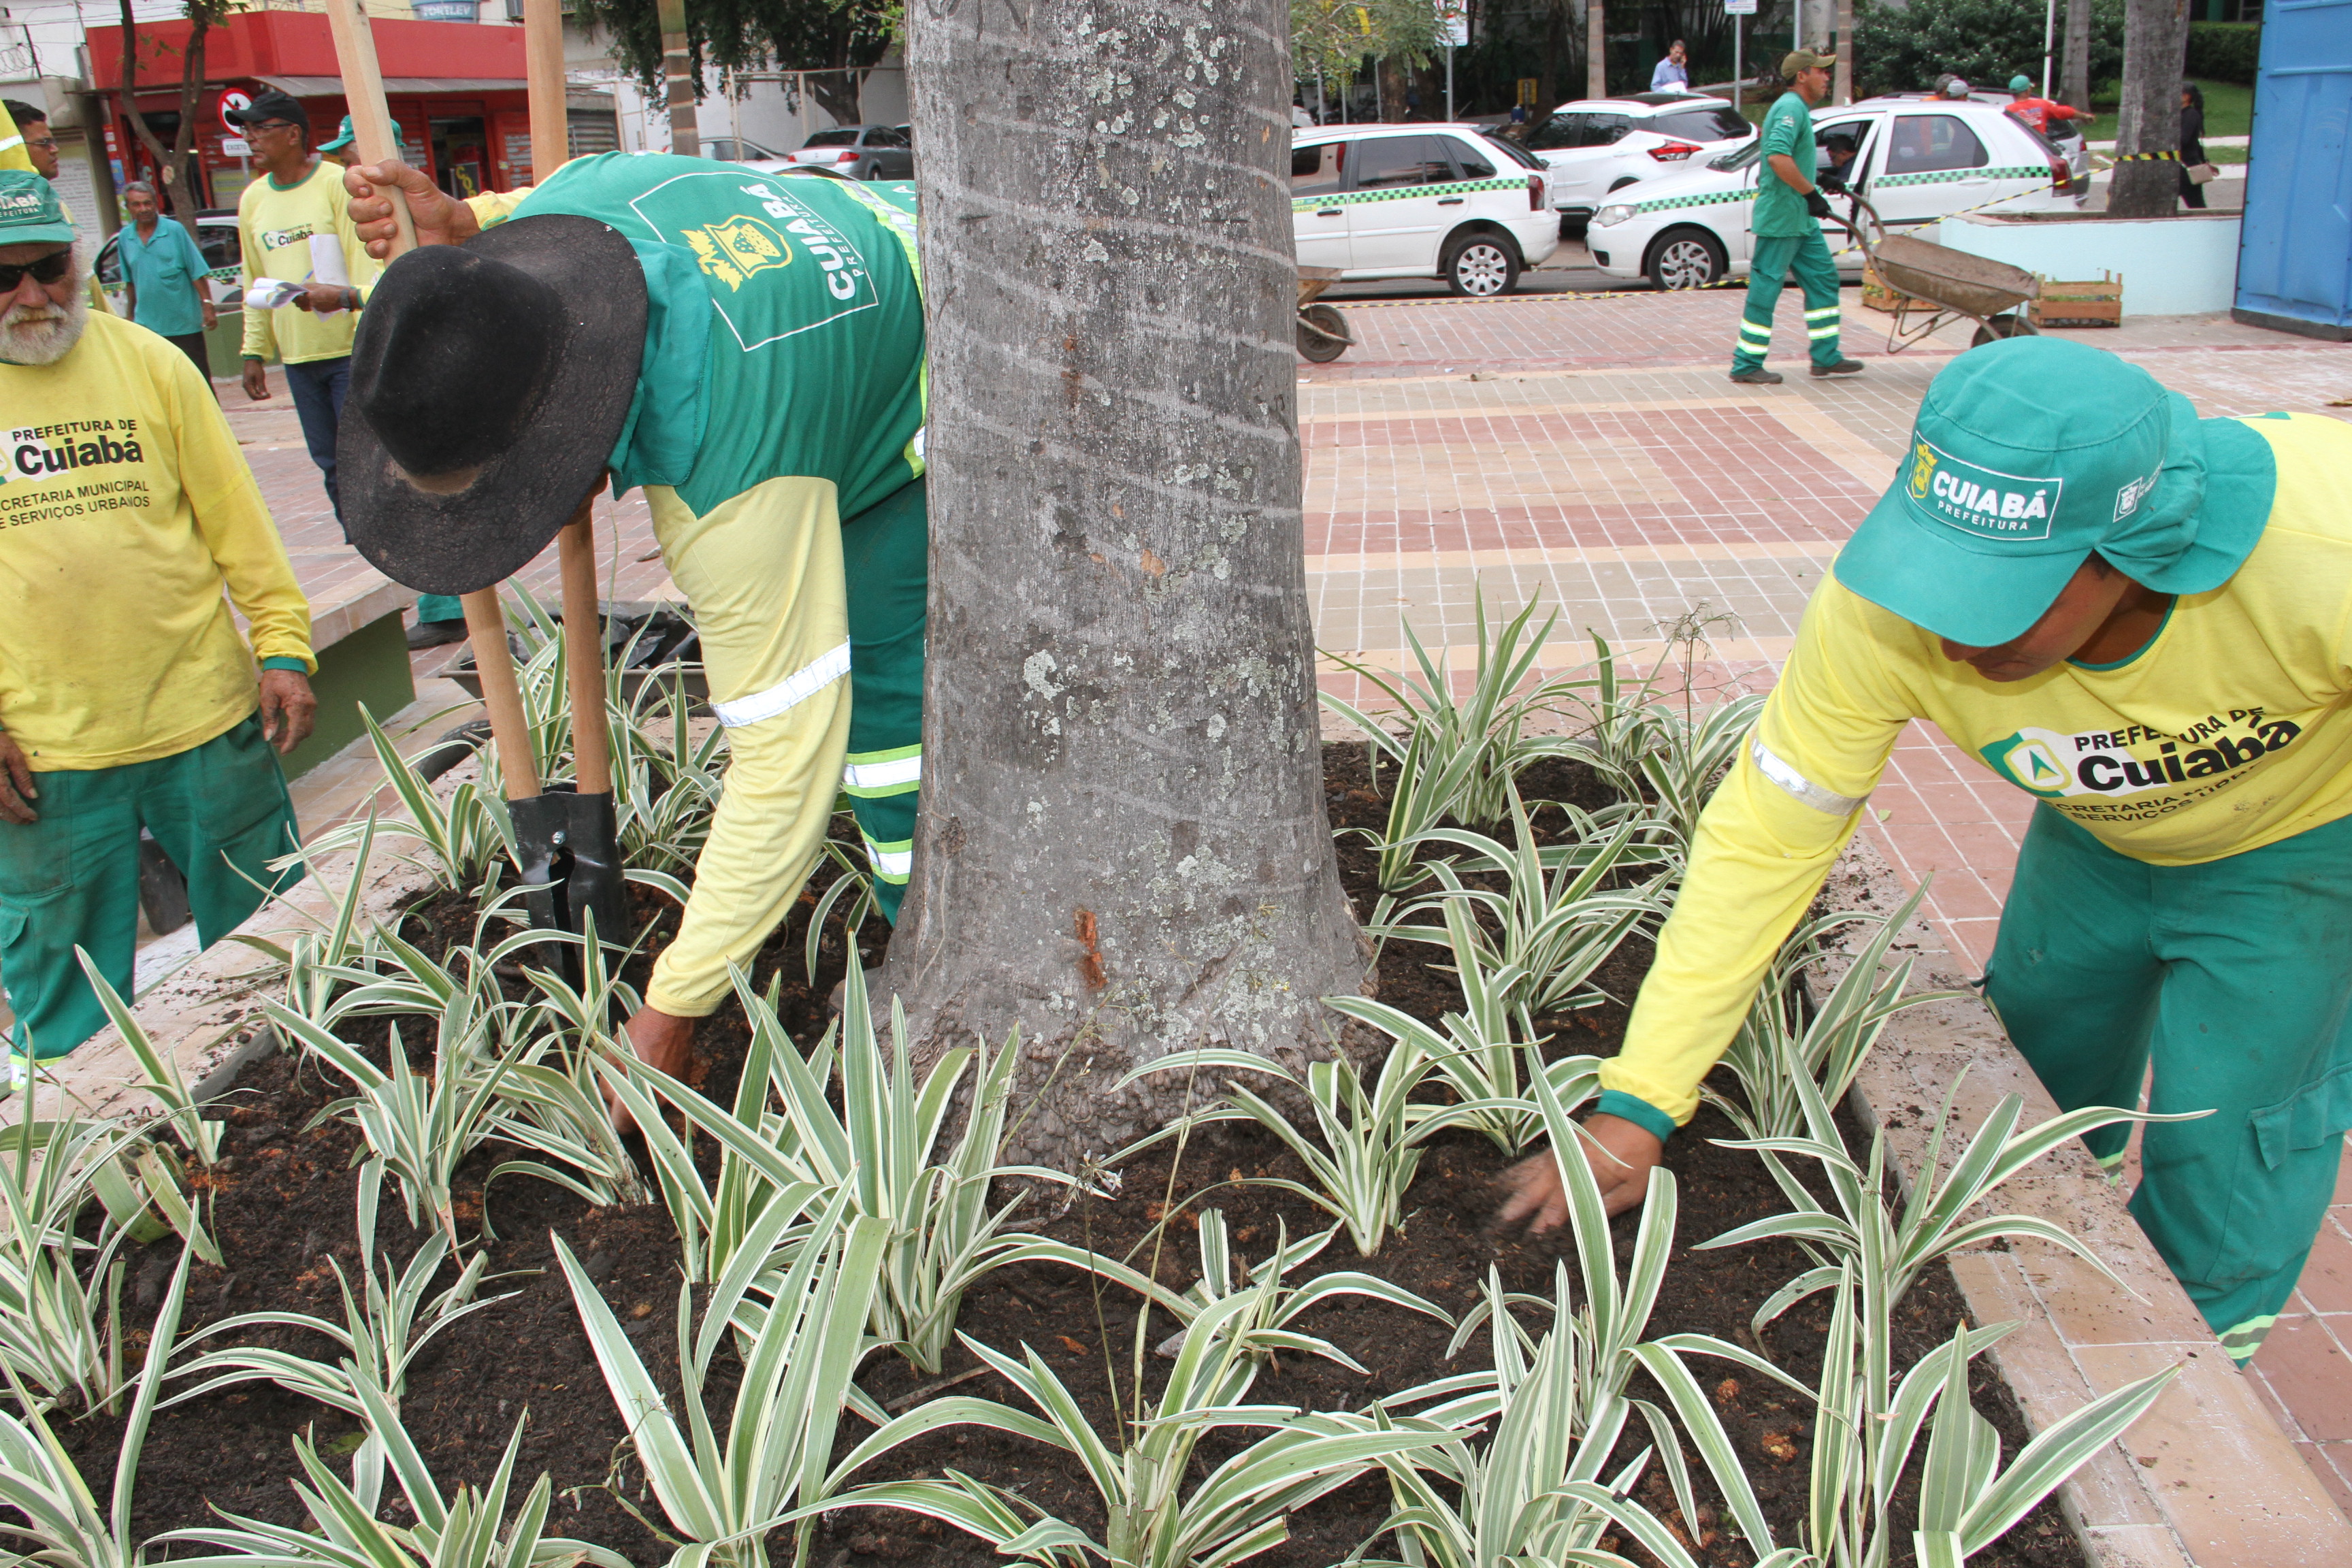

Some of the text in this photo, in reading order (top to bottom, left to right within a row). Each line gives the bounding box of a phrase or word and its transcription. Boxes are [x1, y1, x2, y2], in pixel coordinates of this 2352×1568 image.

[0, 193, 42, 210] IABÁ
[739, 183, 855, 300] CUIABÁ
[781, 196, 865, 278] PREFEITURA
[12, 419, 137, 442] PREFEITURA DE
[15, 433, 144, 475] Cuiabá
[0, 480, 150, 512] CRETARIA MUNICIPAL
[10, 504, 84, 526] SERVIÇOS
[1933, 470, 2047, 519] CUIABÁ
[1938, 500, 2029, 531] PREFEITURA
[2074, 706, 2267, 751] PREFEURA DE
[2078, 715, 2302, 791] Cuiabá
